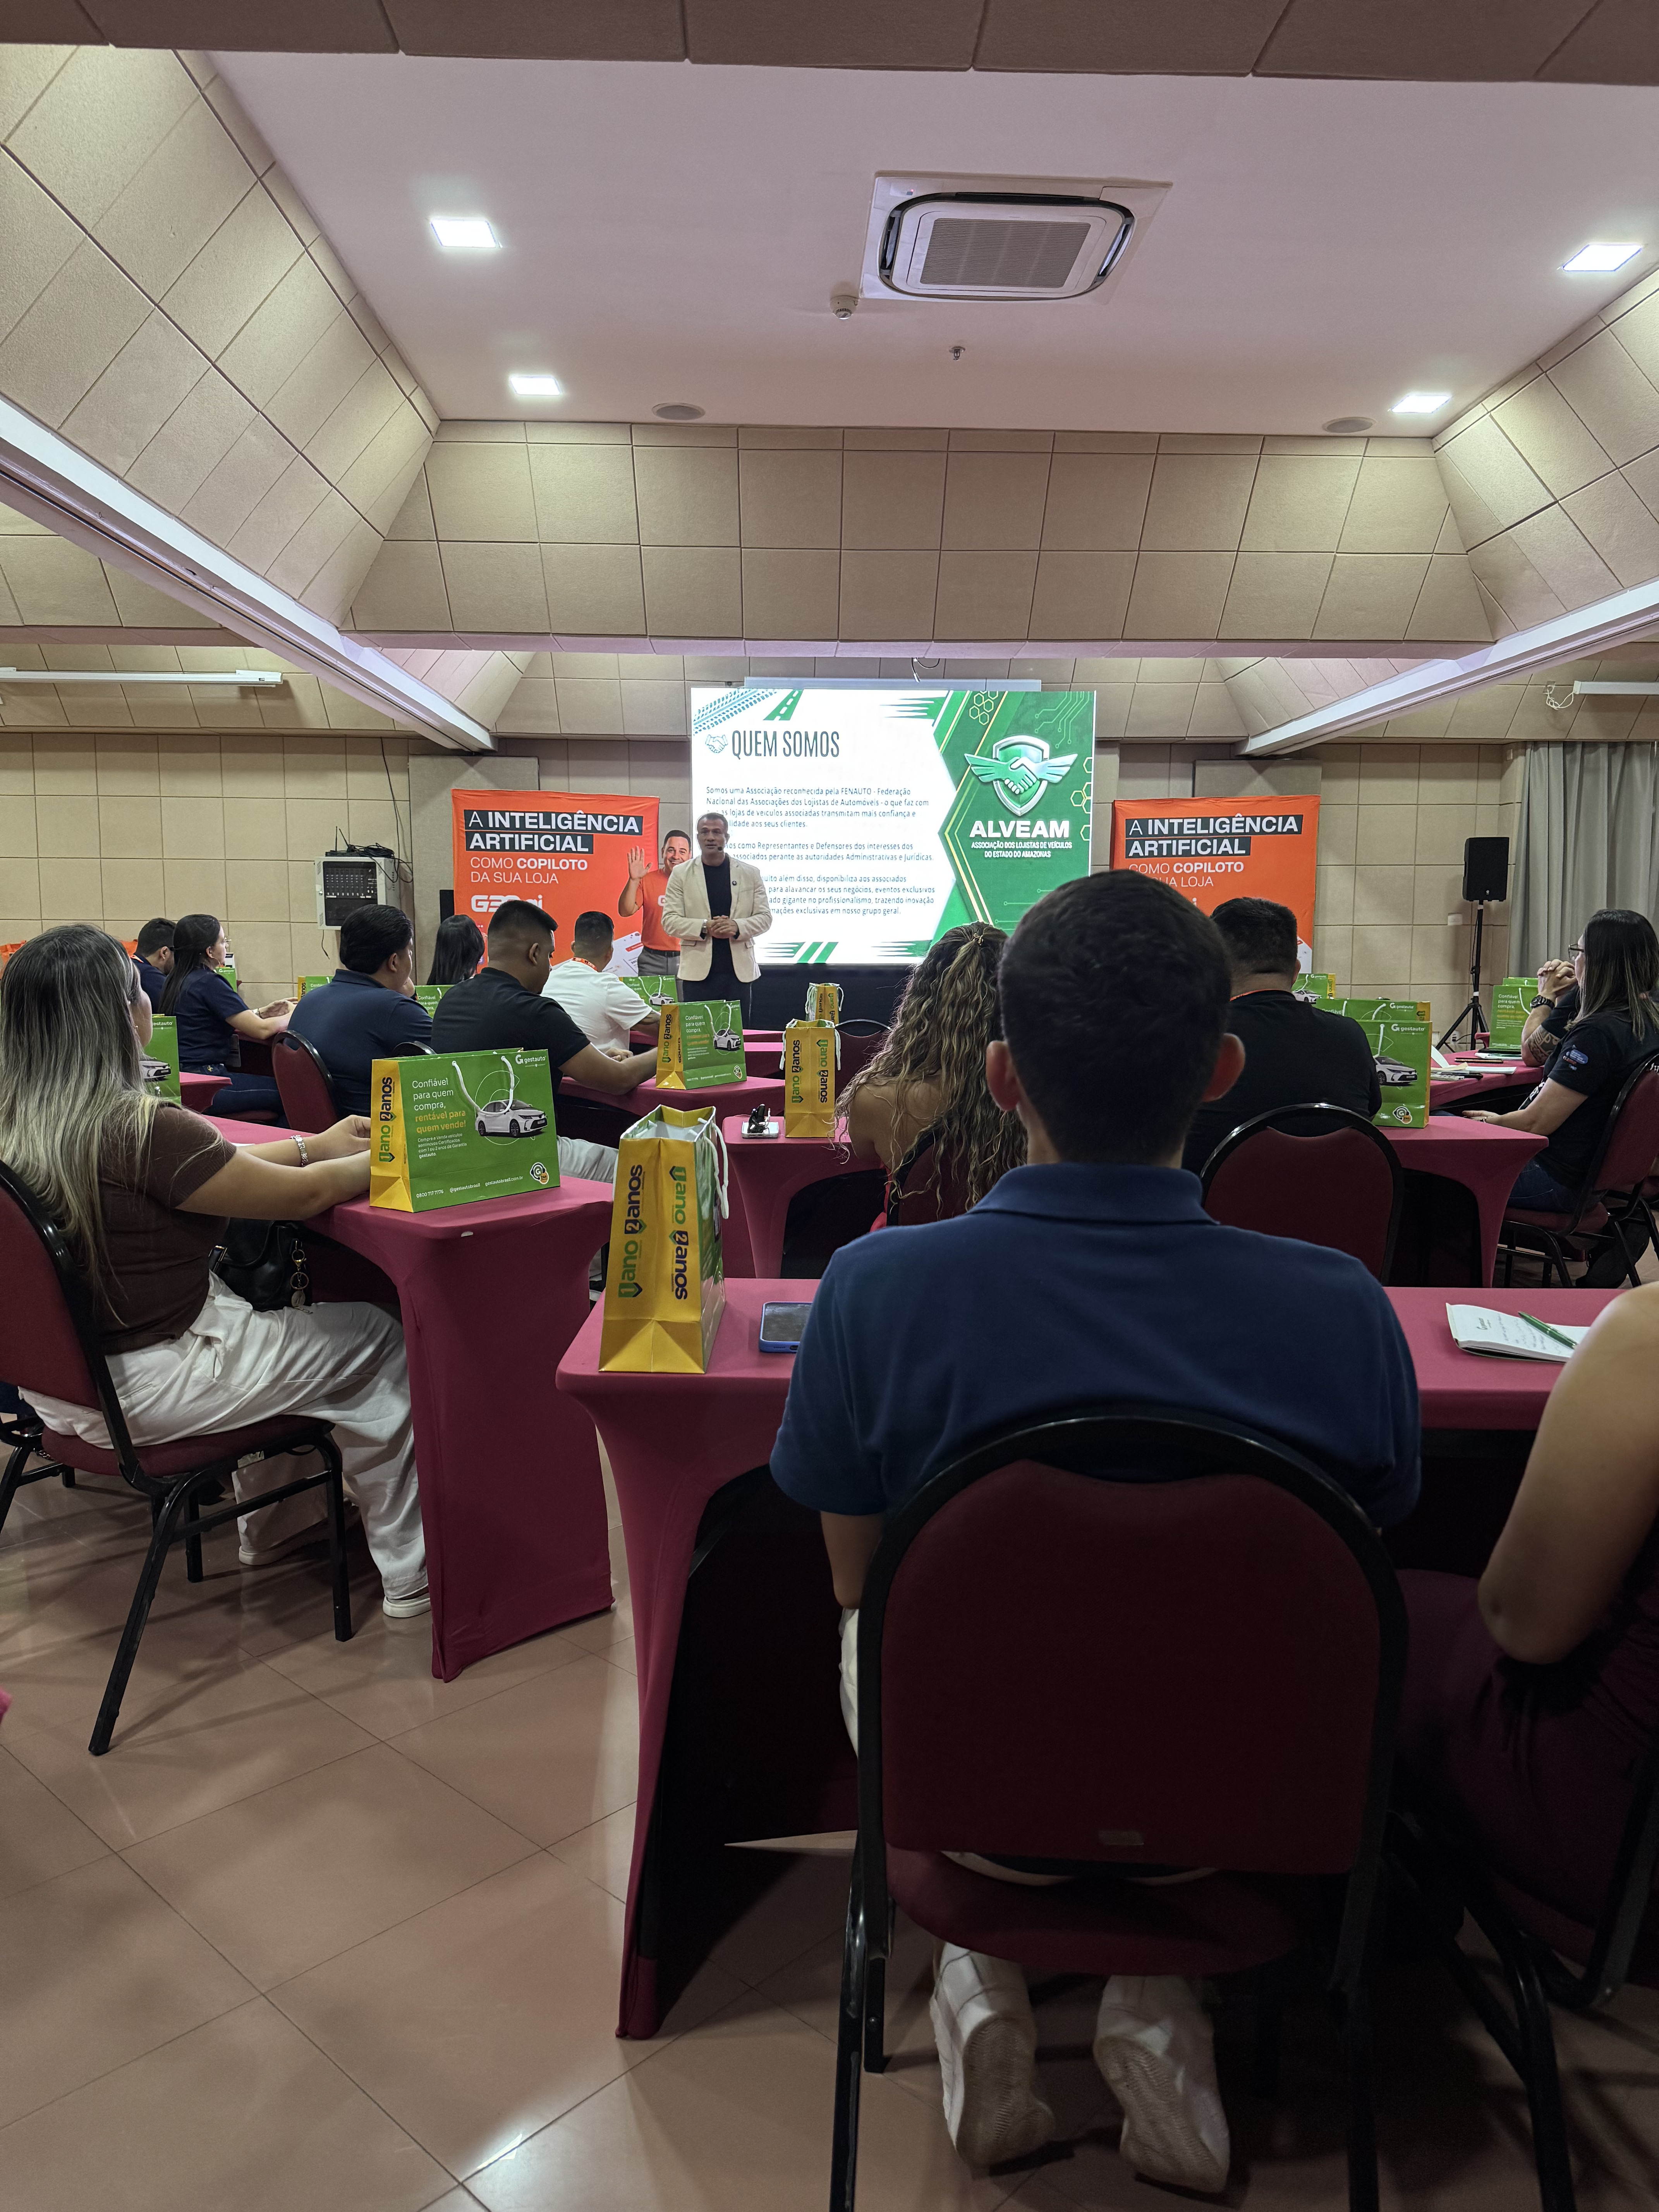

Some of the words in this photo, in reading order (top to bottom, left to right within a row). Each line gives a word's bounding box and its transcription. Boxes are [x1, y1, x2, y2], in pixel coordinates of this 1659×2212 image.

[732, 731, 777, 760] QUEM
[783, 731, 840, 758] SOMOS
[746, 787, 781, 796] Associação
[825, 787, 839, 796] pela
[878, 788, 910, 797] Federação
[750, 799, 789, 807] Associações
[805, 799, 829, 807] Lojistas
[730, 809, 744, 817] lojas
[879, 810, 910, 819] confiança
[469, 811, 483, 827] A
[488, 810, 639, 833] INTELIGÊNCIA
[1129, 820, 1142, 835] A
[1148, 813, 1298, 835] INTELIGÊNCIA
[969, 820, 1069, 838] ALVEAM
[469, 833, 589, 852] ARTIFICIAL
[758, 842, 808, 851] Representantes
[971, 841, 1003, 850] ASSOCIAÇÃO
[1048, 841, 1072, 849] VEÍCULOS
[1128, 838, 1245, 856] ARTIFICIAL
[471, 857, 513, 869] COMO
[517, 858, 587, 870] COPILOTO
[1129, 863, 1170, 874] COMO
[1173, 862, 1244, 874] COPILOTO
[471, 872, 490, 883] DA
[493, 872, 522, 883] SUA
[526, 872, 558, 884] LOJA
[797, 875, 815, 883] disso,
[1181, 876, 1213, 887] LOJA
[783, 896, 806, 905] gigante
[906, 897, 934, 905] inovação
[515, 1054, 523, 1064] G
[412, 1078, 448, 1089] Confiável
[413, 1092, 430, 1101] para
[432, 1090, 453, 1099] quem
[414, 1102, 445, 1111] compra,
[415, 1111, 447, 1122] rentável
[449, 1111, 465, 1119] para
[416, 1125, 439, 1134] quem
[440, 1120, 466, 1130] vende!
